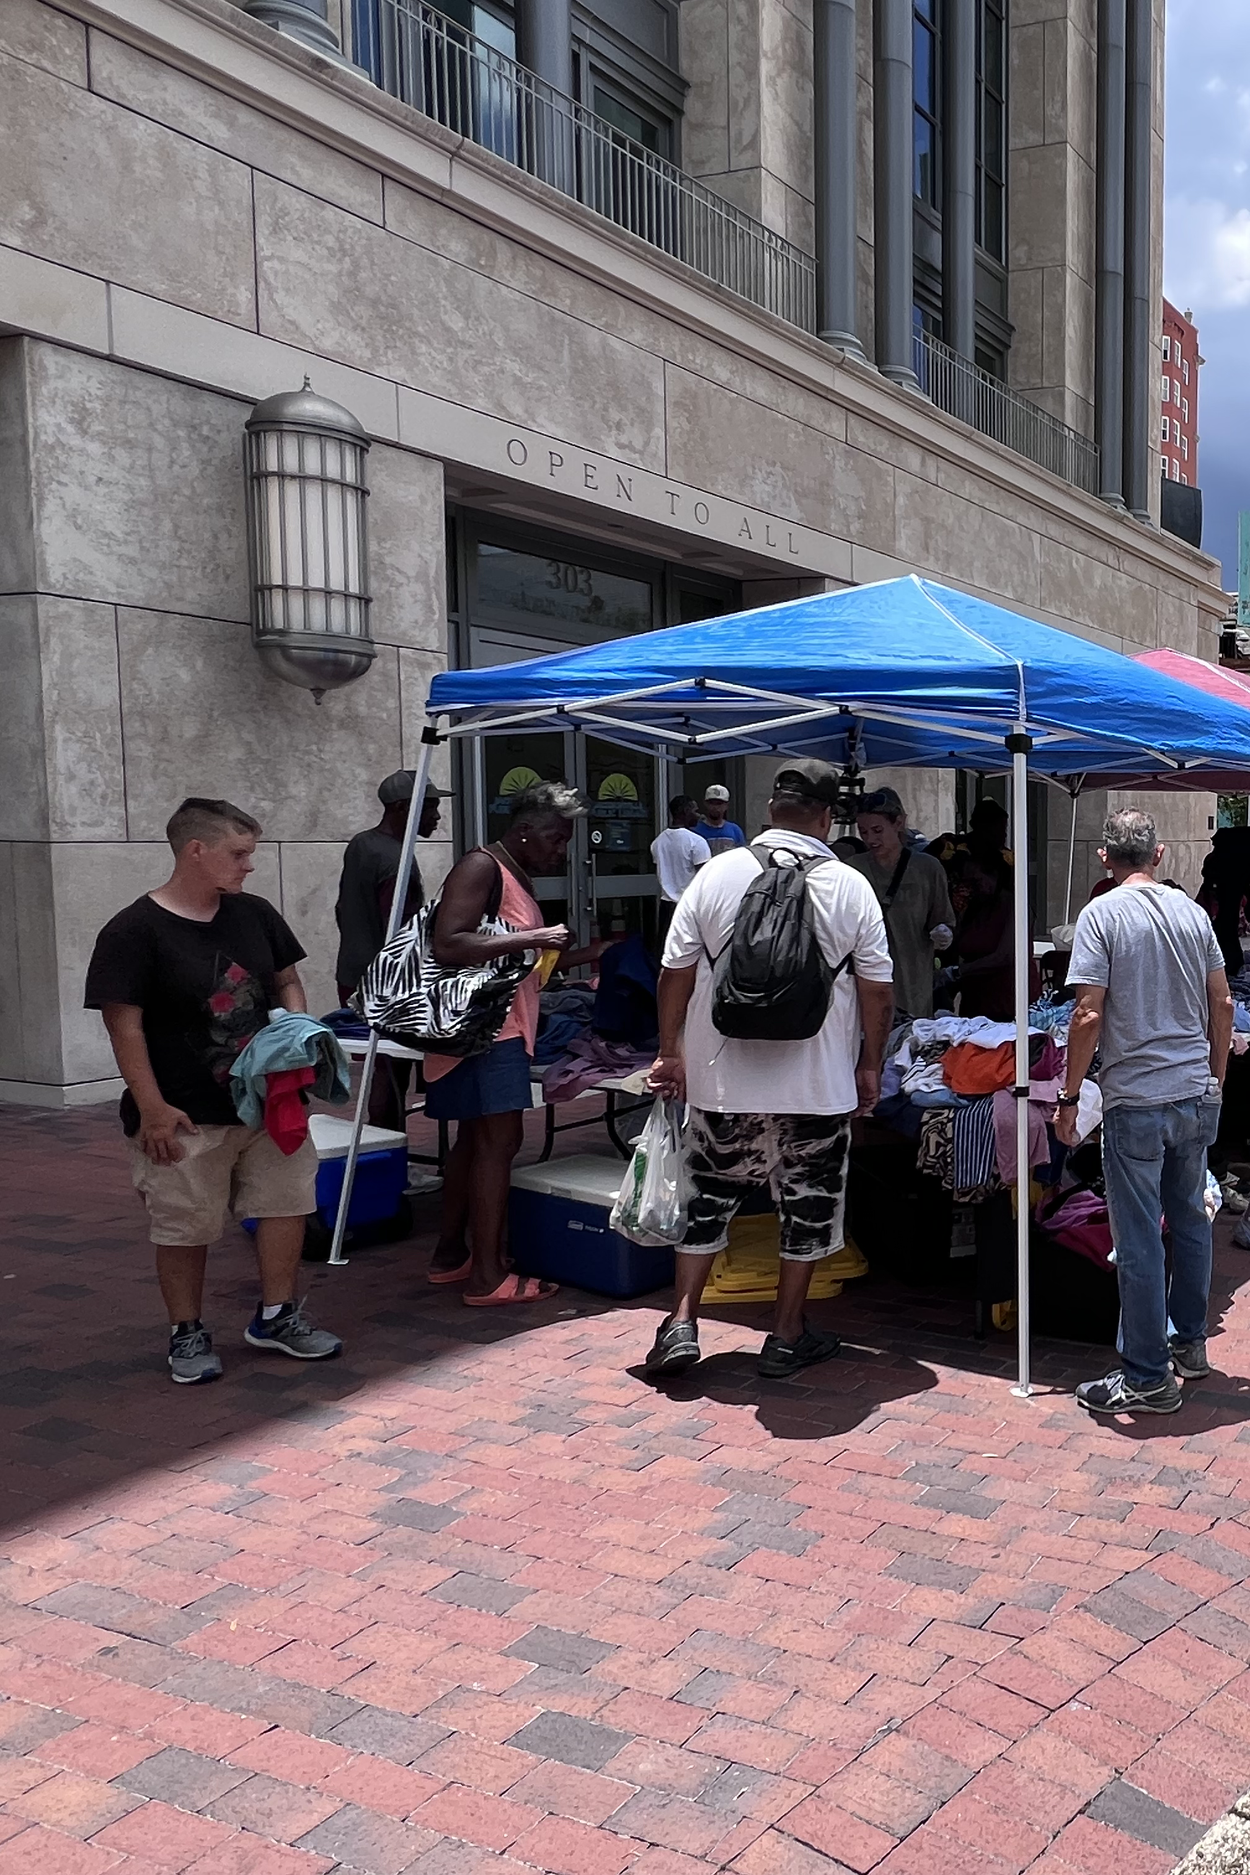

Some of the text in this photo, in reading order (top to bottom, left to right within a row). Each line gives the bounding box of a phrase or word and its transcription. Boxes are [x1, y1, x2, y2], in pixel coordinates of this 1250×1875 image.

[506, 438, 800, 555] OPEN TO ALL
[546, 561, 593, 597] 303
